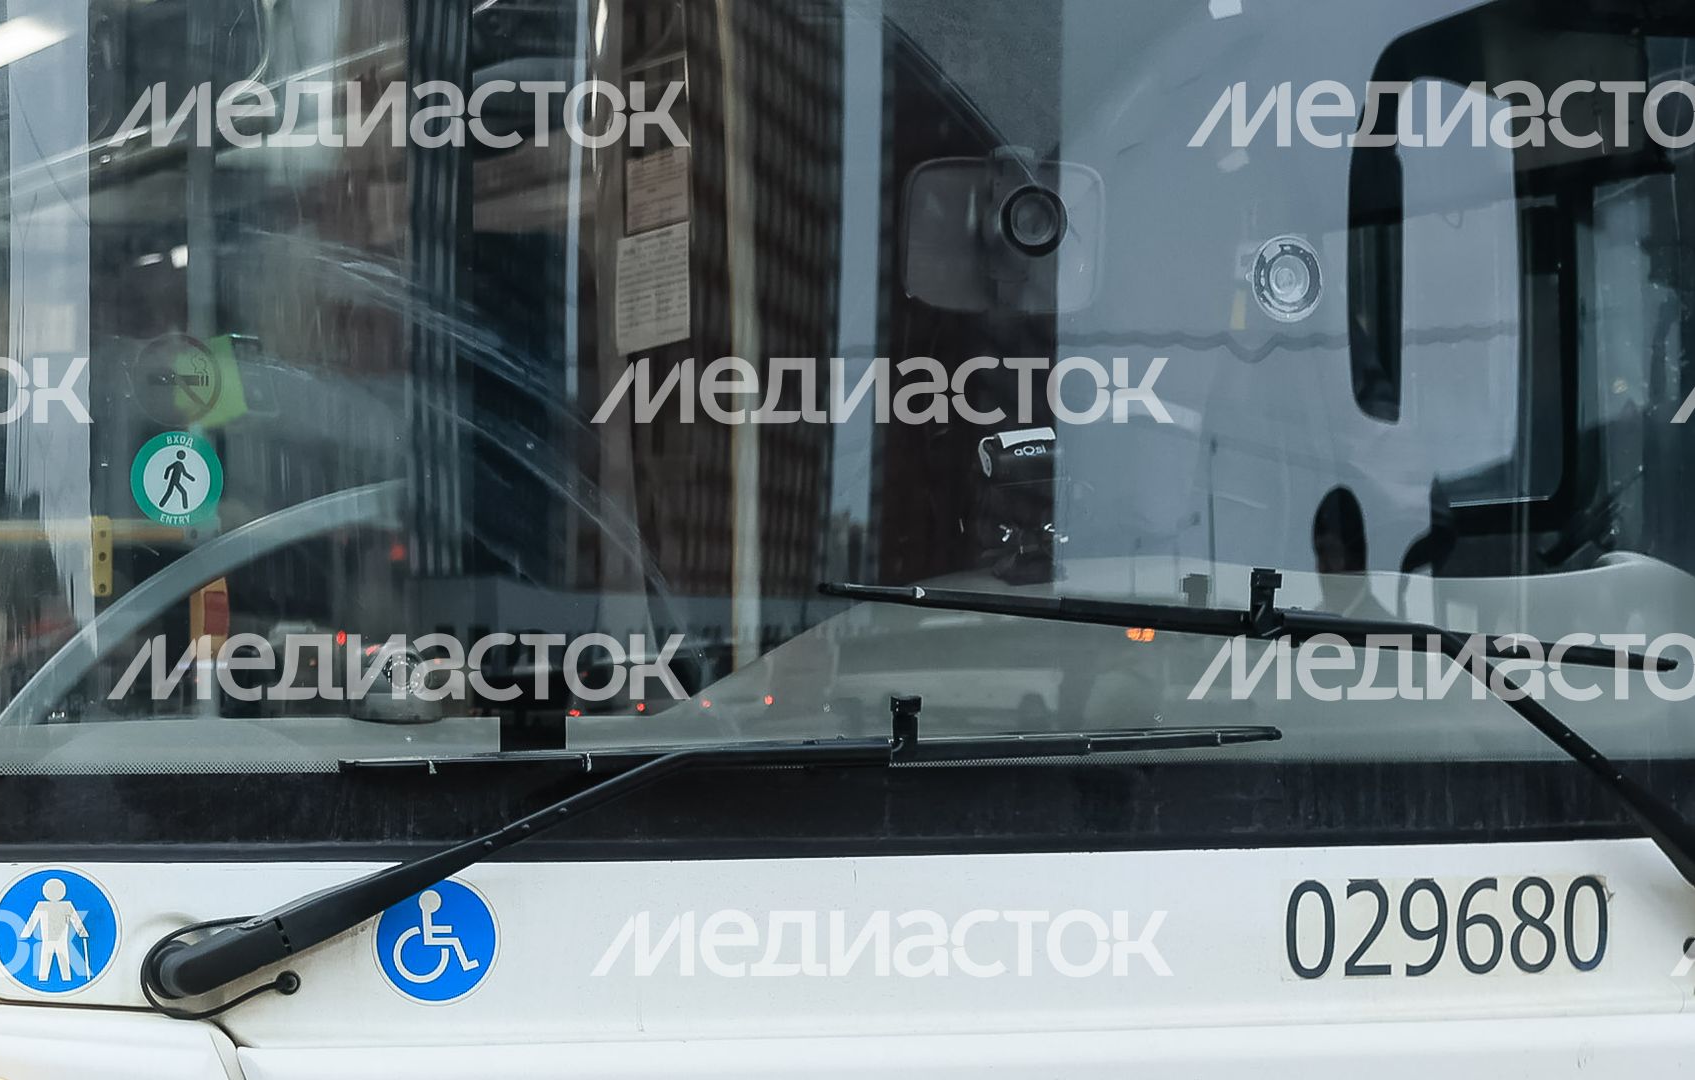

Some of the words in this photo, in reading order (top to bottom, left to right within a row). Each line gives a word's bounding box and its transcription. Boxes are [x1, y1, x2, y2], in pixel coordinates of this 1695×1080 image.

[166, 435, 194, 448] ВХОД
[160, 513, 191, 526] ENTRY
[1285, 875, 1608, 979] 029680
